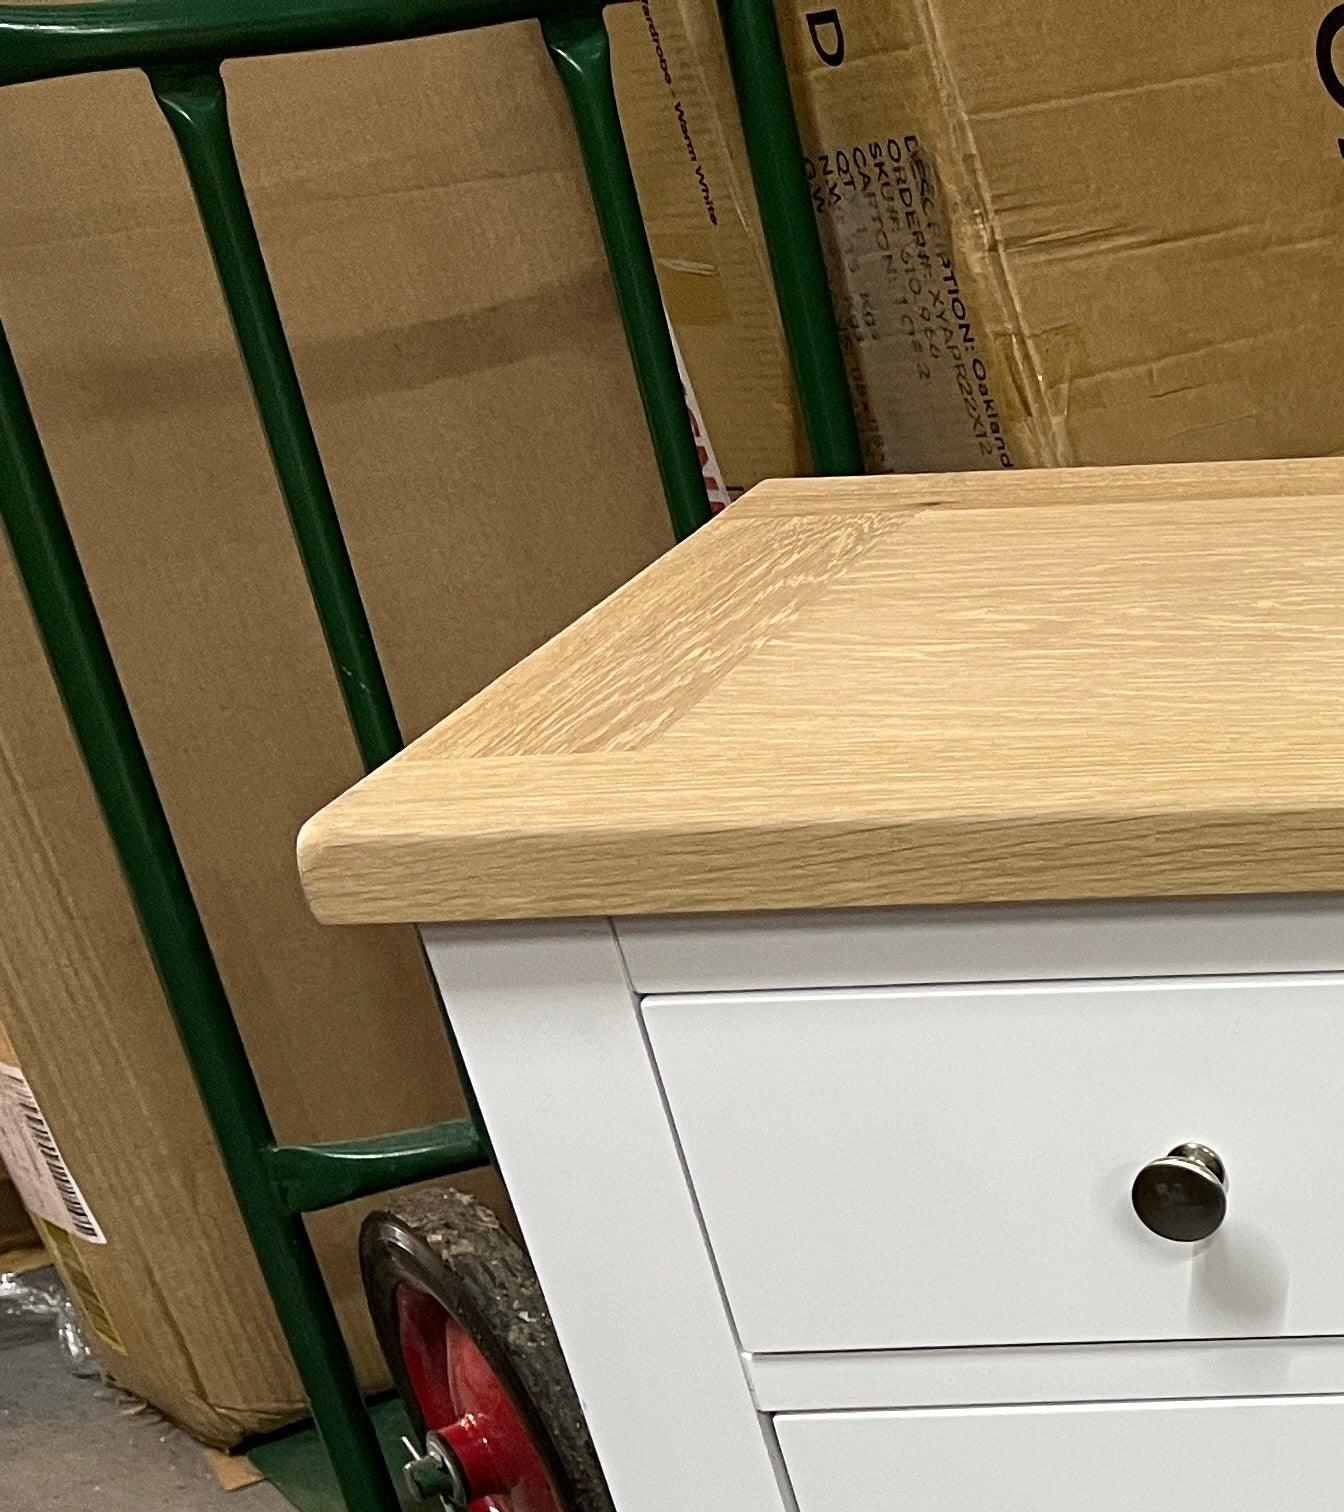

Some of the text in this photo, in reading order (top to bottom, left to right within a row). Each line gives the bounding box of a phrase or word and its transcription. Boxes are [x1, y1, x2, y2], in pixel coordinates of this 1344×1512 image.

[805, 9, 844, 67] D
[641, 0, 672, 84] ardrobe
[675, 101, 697, 162] Warm
[696, 165, 718, 226] White
[972, 358, 1013, 468] Oakland
